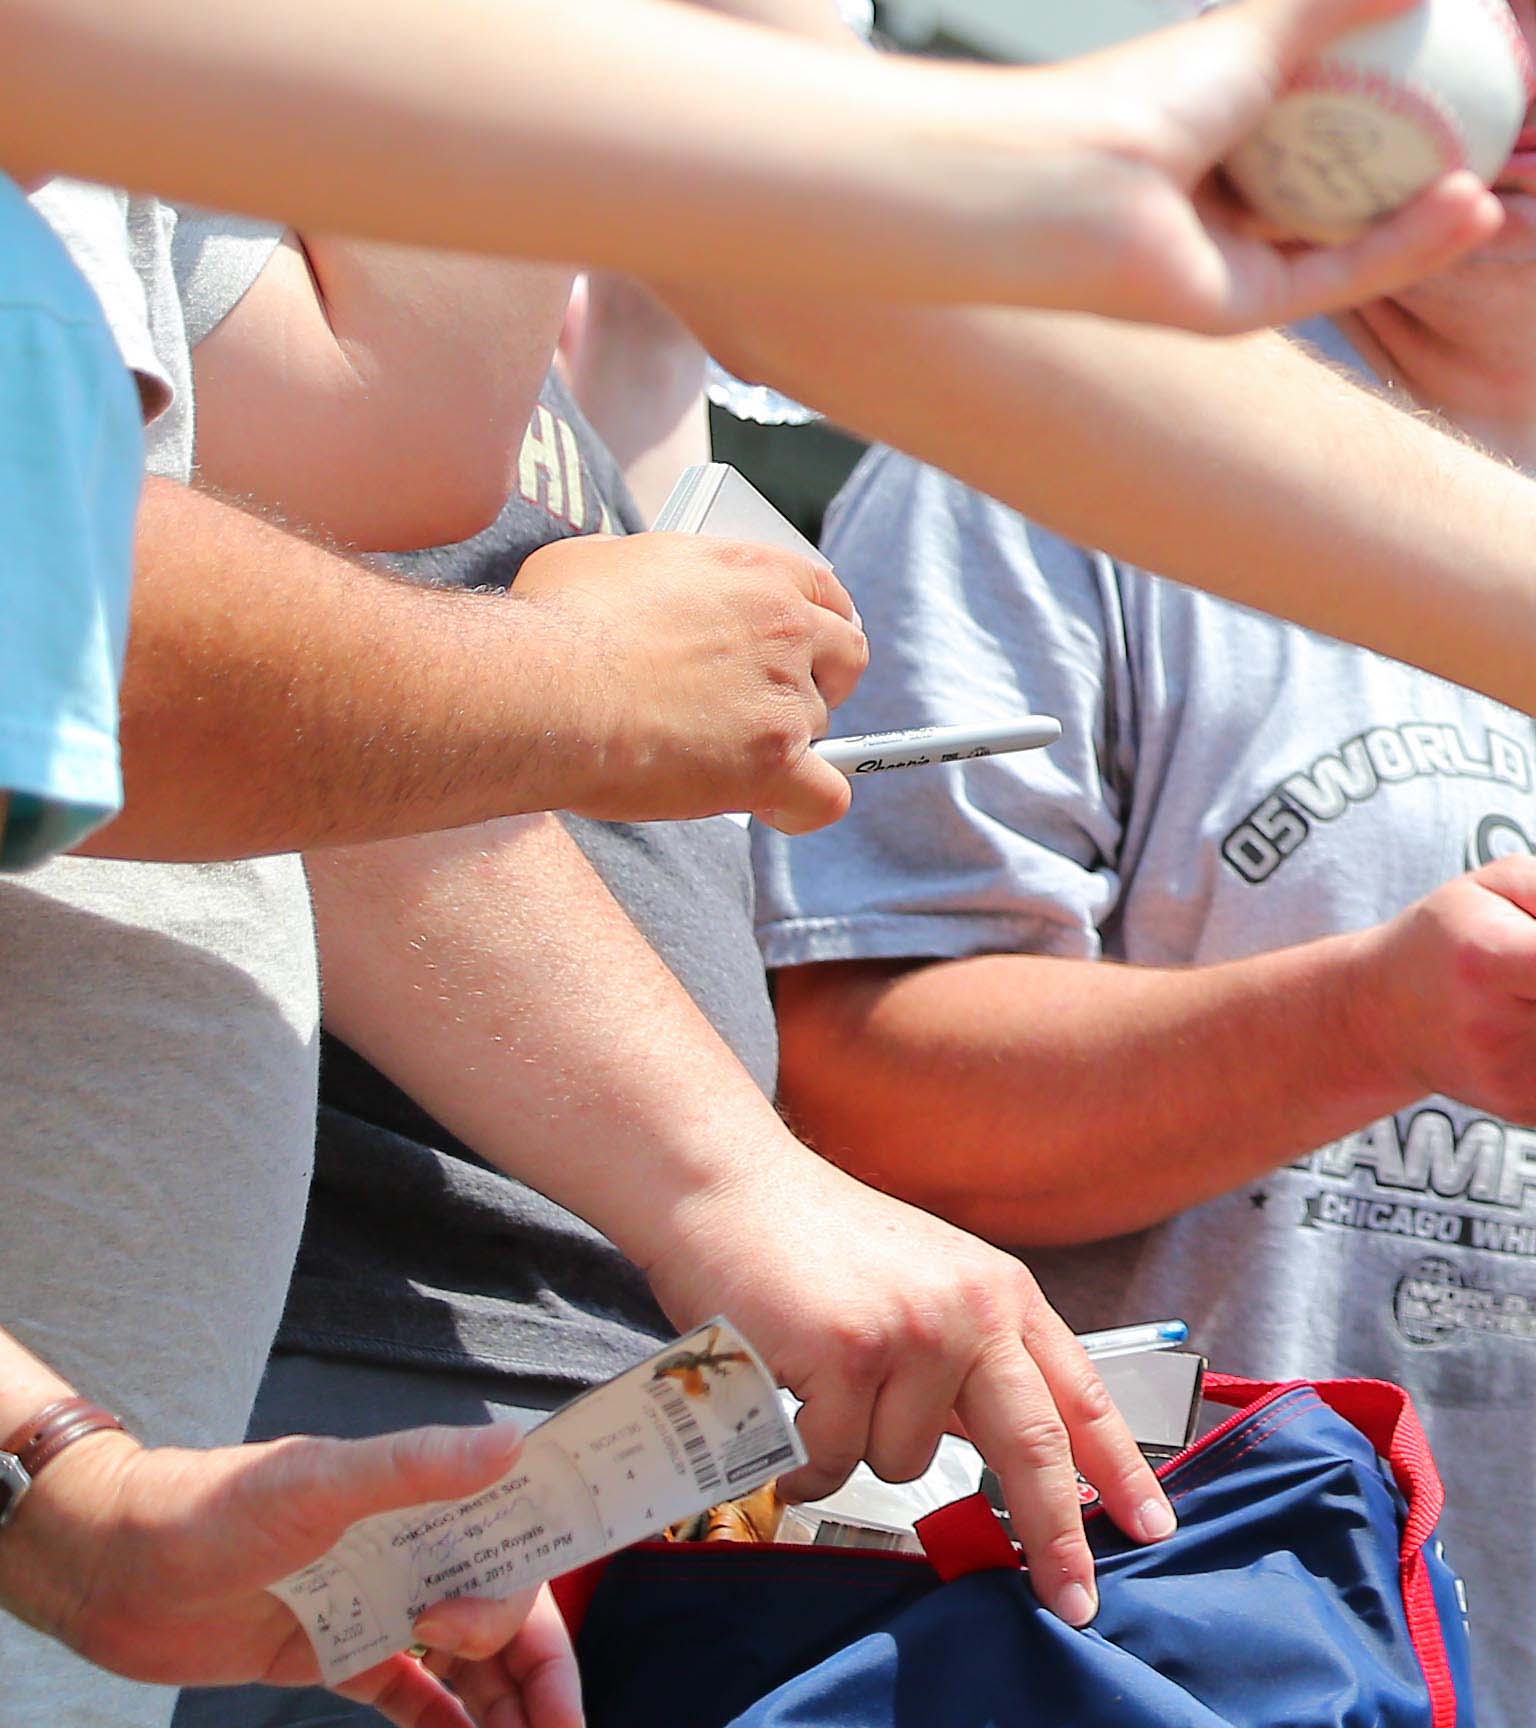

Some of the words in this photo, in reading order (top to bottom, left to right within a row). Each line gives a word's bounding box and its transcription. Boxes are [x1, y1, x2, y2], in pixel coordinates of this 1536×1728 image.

[1221, 788, 1309, 885] 05
[1281, 722, 1533, 822] WORLD
[1318, 1192, 1463, 1245] CHICAGO
[391, 1513, 456, 1548] CHICAGO
[423, 1559, 473, 1589] Kansas
[473, 1544, 500, 1565] City
[501, 1523, 546, 1553] Royals
[552, 1532, 574, 1553] PM
